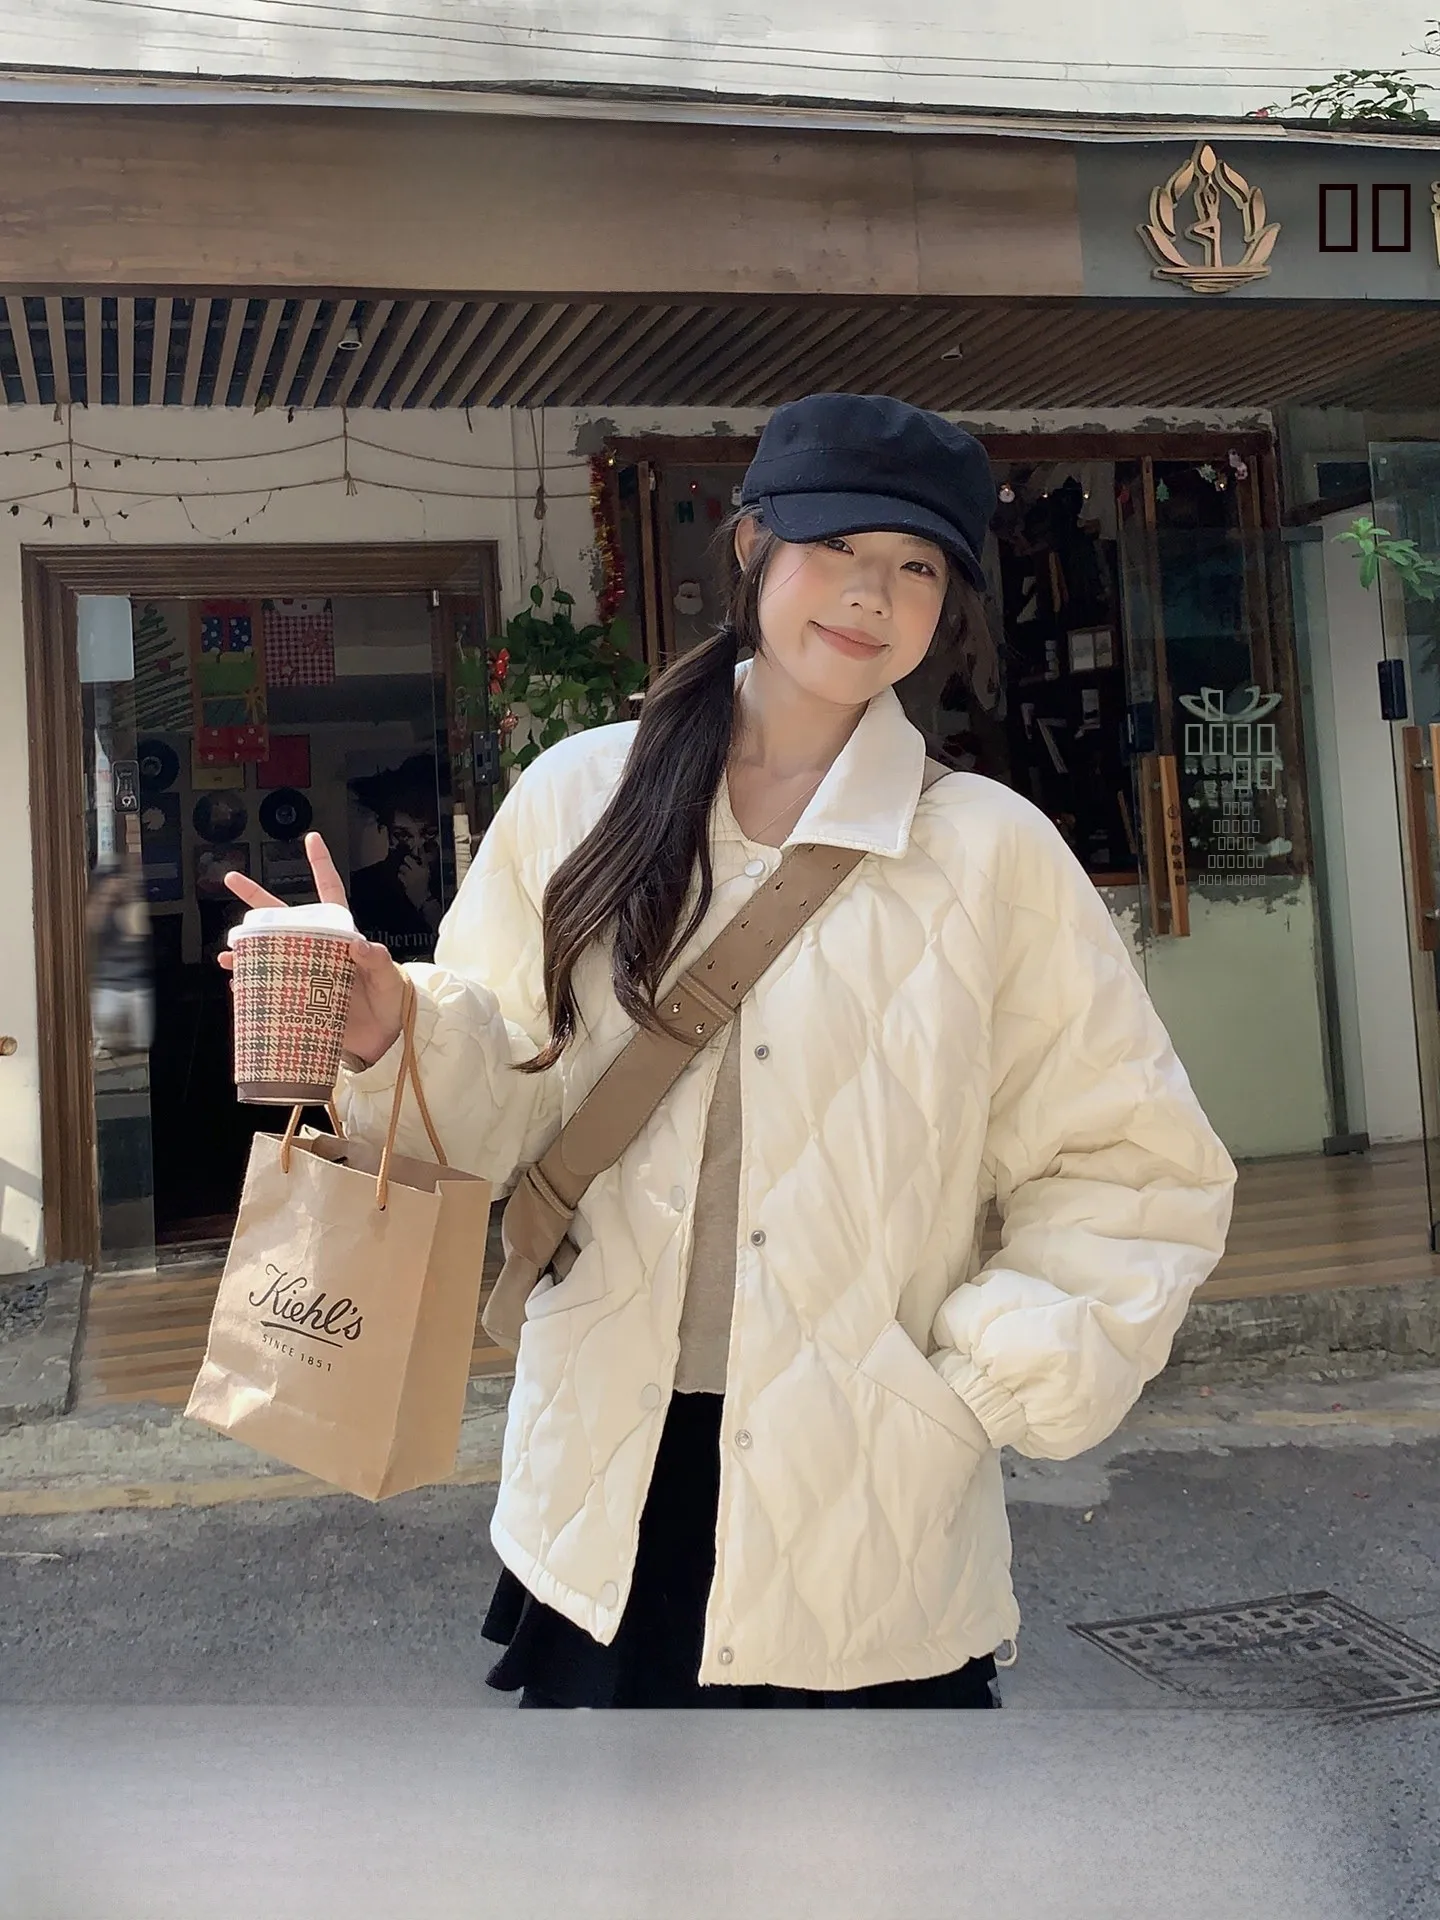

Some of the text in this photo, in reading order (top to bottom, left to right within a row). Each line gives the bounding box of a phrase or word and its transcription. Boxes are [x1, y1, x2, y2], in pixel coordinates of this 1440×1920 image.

[284, 1014, 312, 1025] store
[315, 1016, 327, 1029] by
[249, 1263, 363, 1340] Kiehl's
[262, 1334, 332, 1372] SINCE 1851
